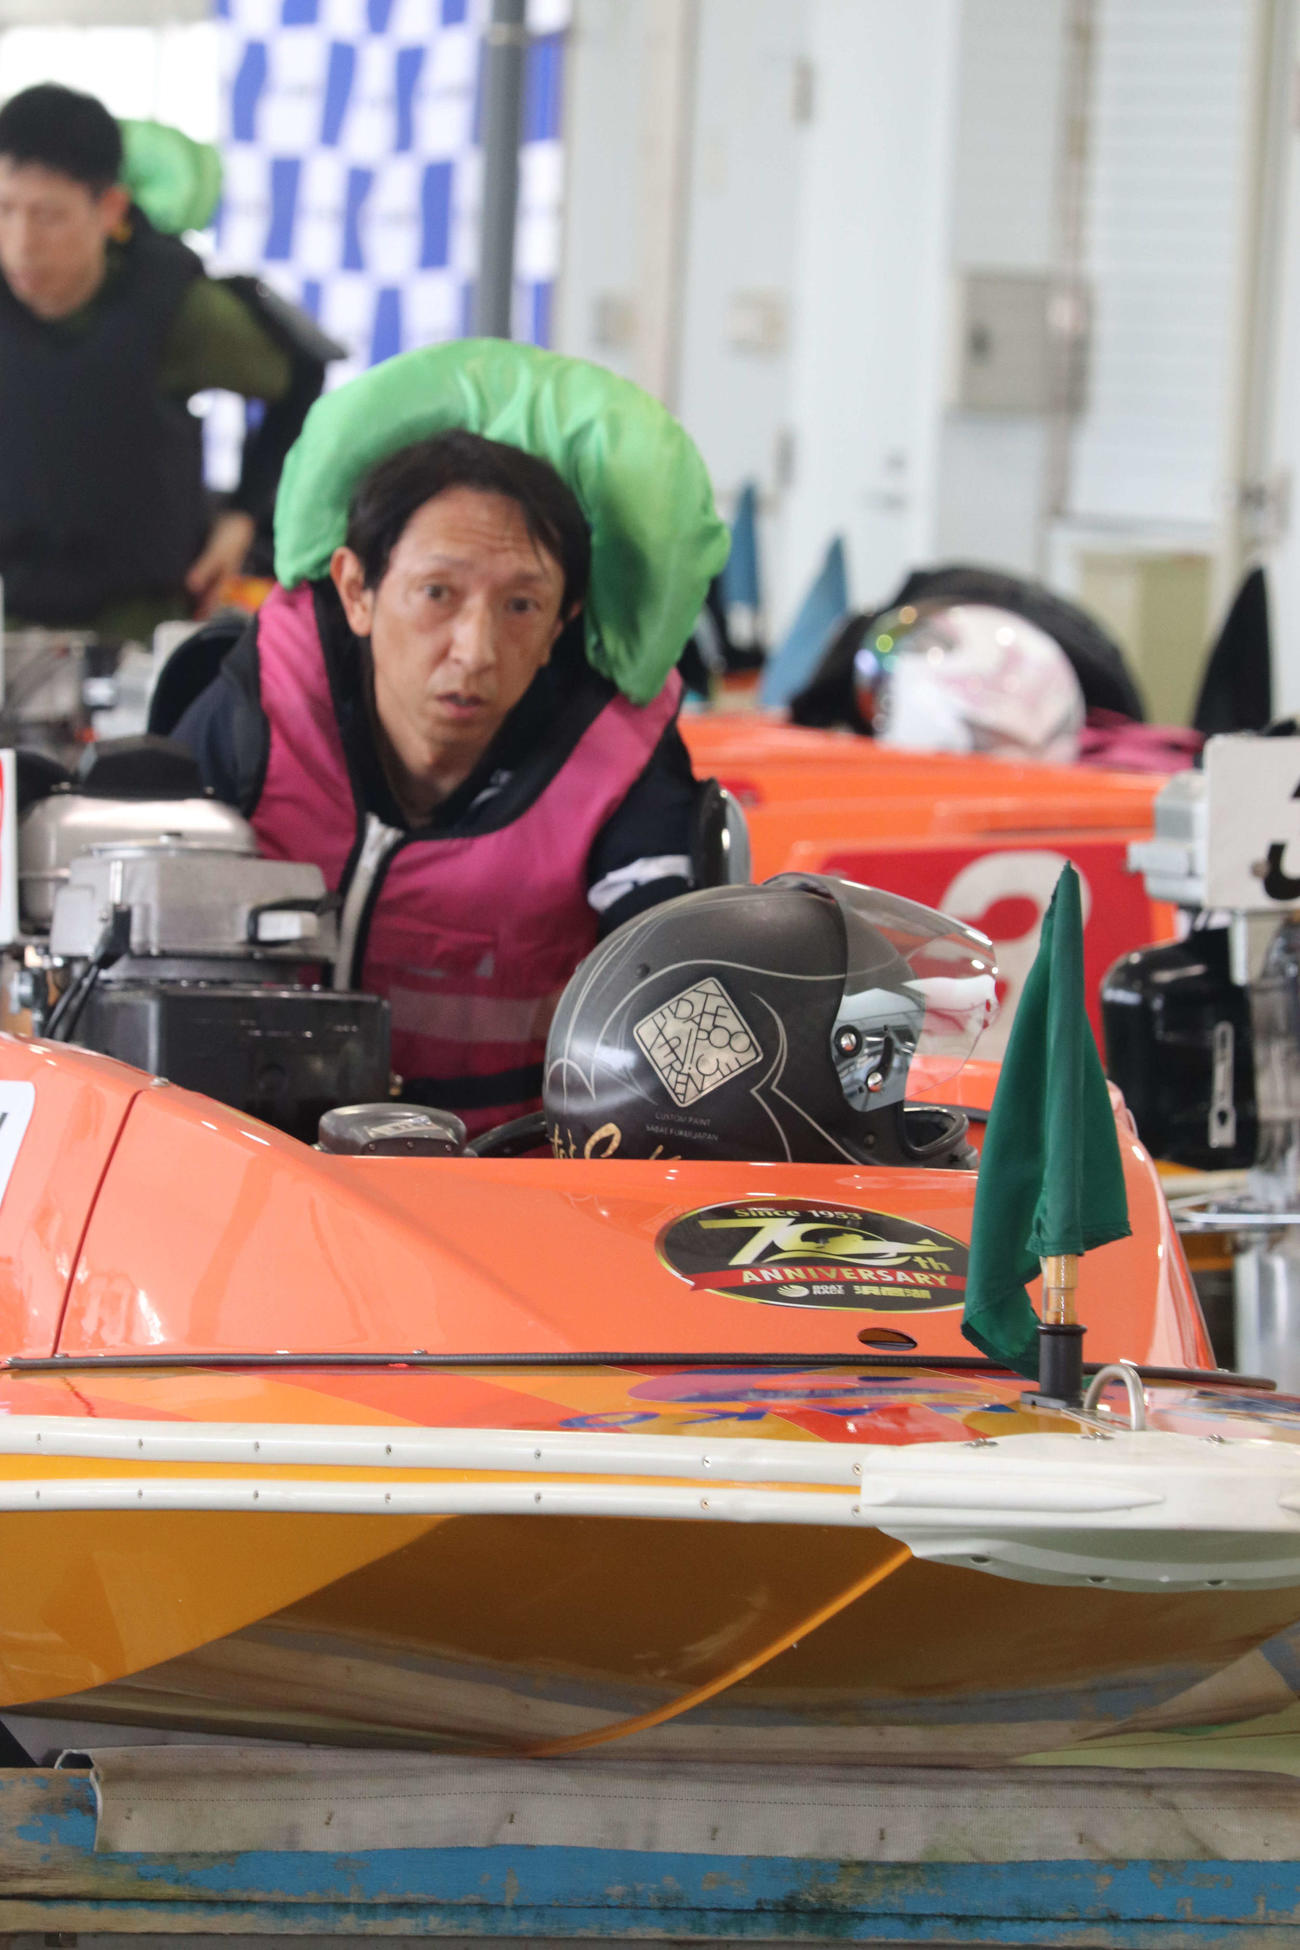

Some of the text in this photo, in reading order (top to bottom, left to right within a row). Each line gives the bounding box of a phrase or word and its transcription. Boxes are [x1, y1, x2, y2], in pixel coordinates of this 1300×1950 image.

[734, 1207, 863, 1221] Since 1953
[742, 1267, 949, 1287] ANNIVERSARY
